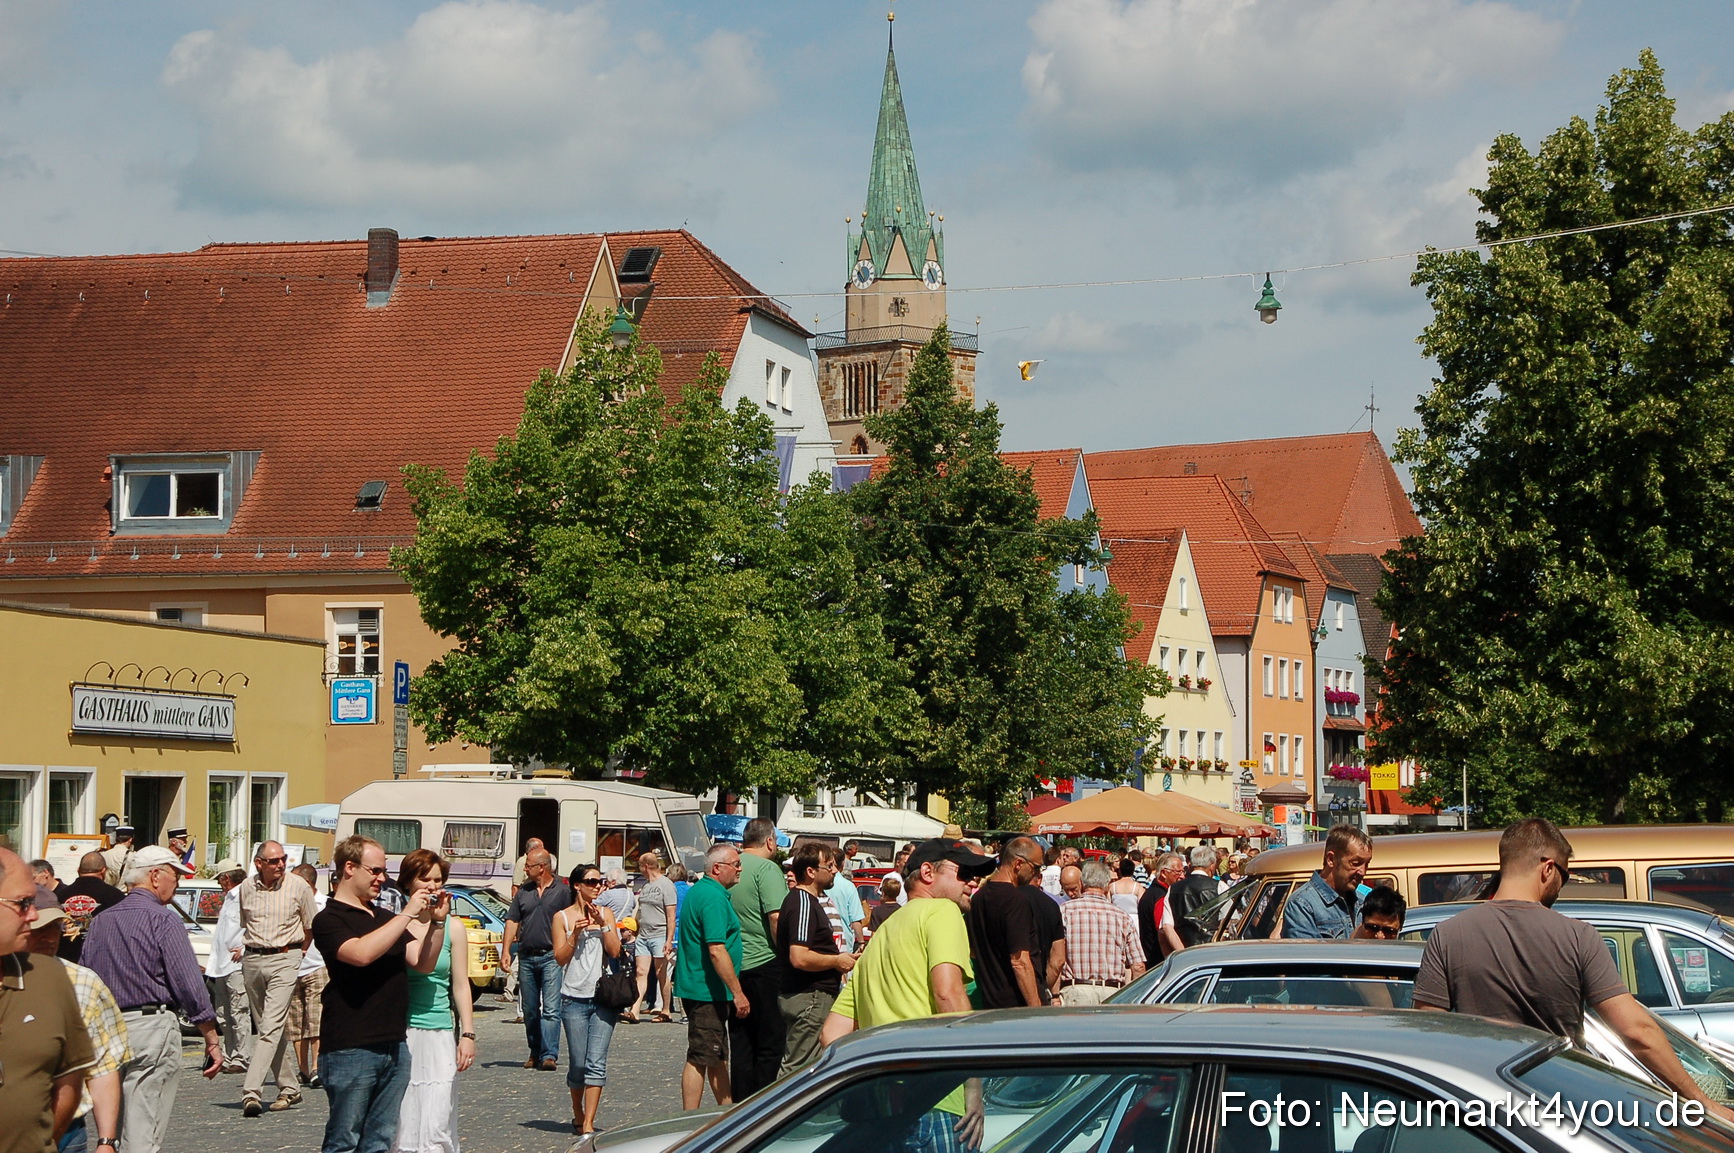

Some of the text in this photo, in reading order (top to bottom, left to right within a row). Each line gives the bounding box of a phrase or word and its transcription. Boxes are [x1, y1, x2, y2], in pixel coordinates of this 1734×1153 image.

[397, 667, 406, 699] P
[78, 696, 230, 728] GASTHAUS mittlere GANS
